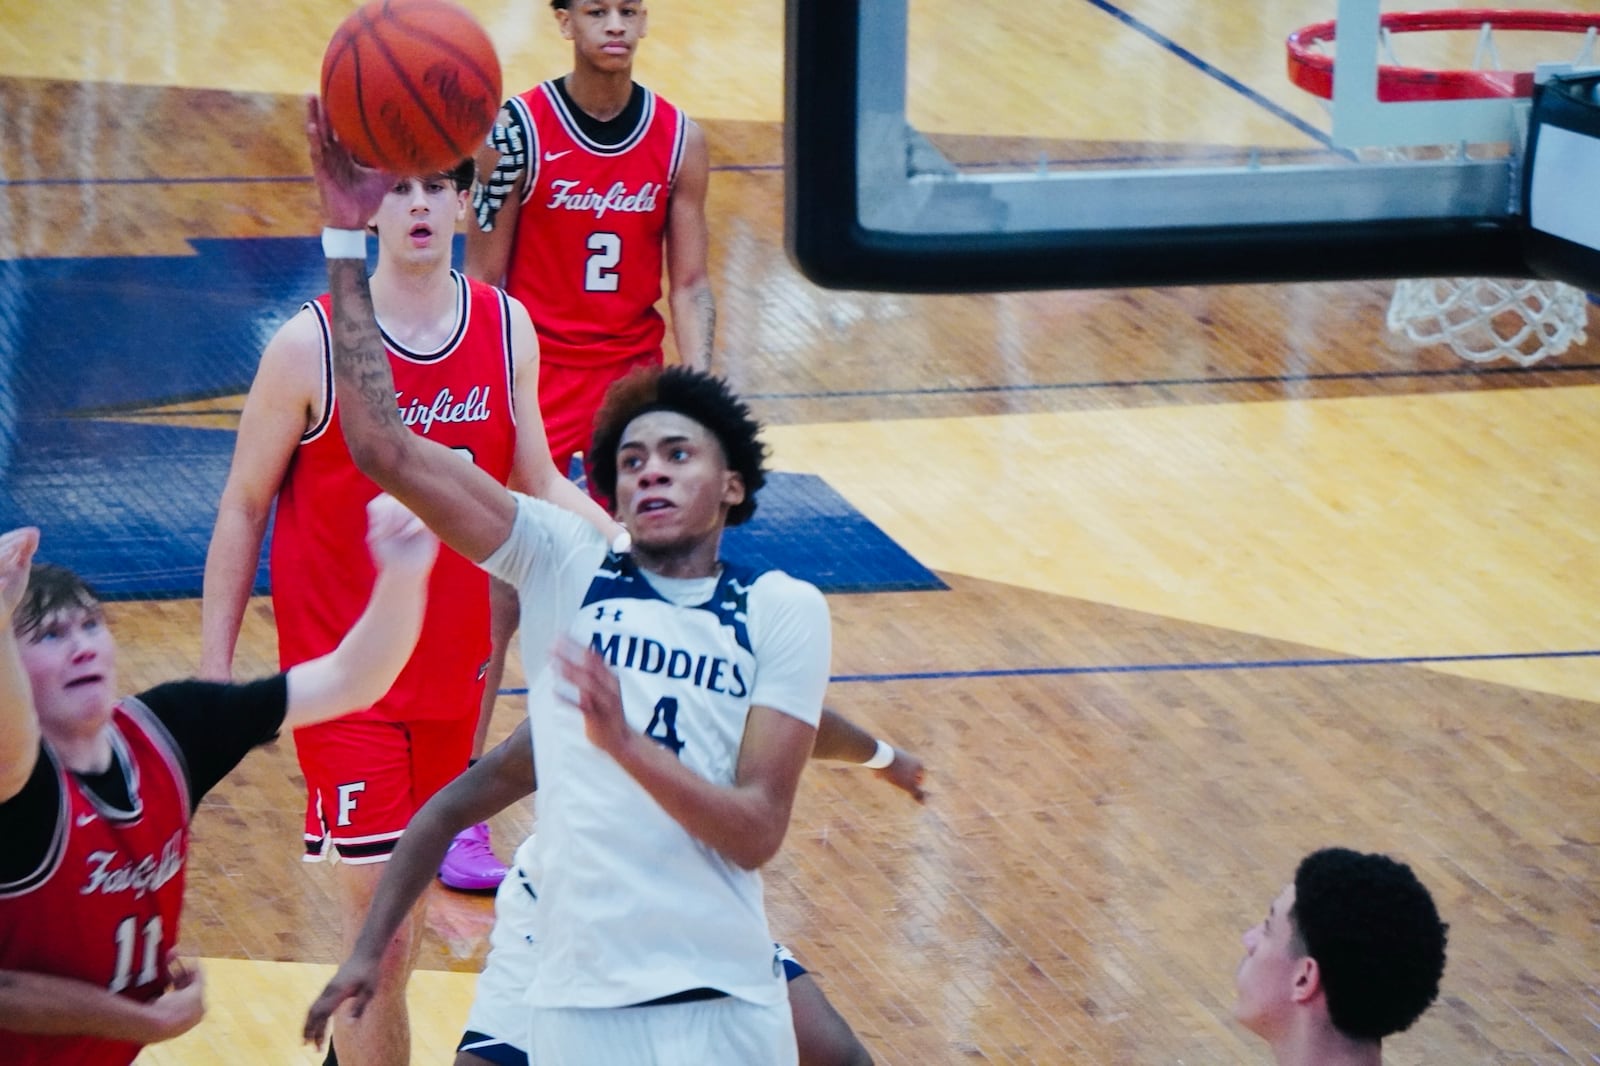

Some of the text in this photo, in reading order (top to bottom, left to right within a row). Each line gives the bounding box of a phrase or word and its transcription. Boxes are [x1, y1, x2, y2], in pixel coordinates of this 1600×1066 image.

[546, 179, 662, 219] Fairfield
[585, 231, 622, 293] 2
[395, 385, 491, 434] irfield
[590, 632, 748, 698] MIDDIES
[644, 696, 686, 755] 4
[336, 781, 366, 827] F
[109, 915, 164, 994] 11
